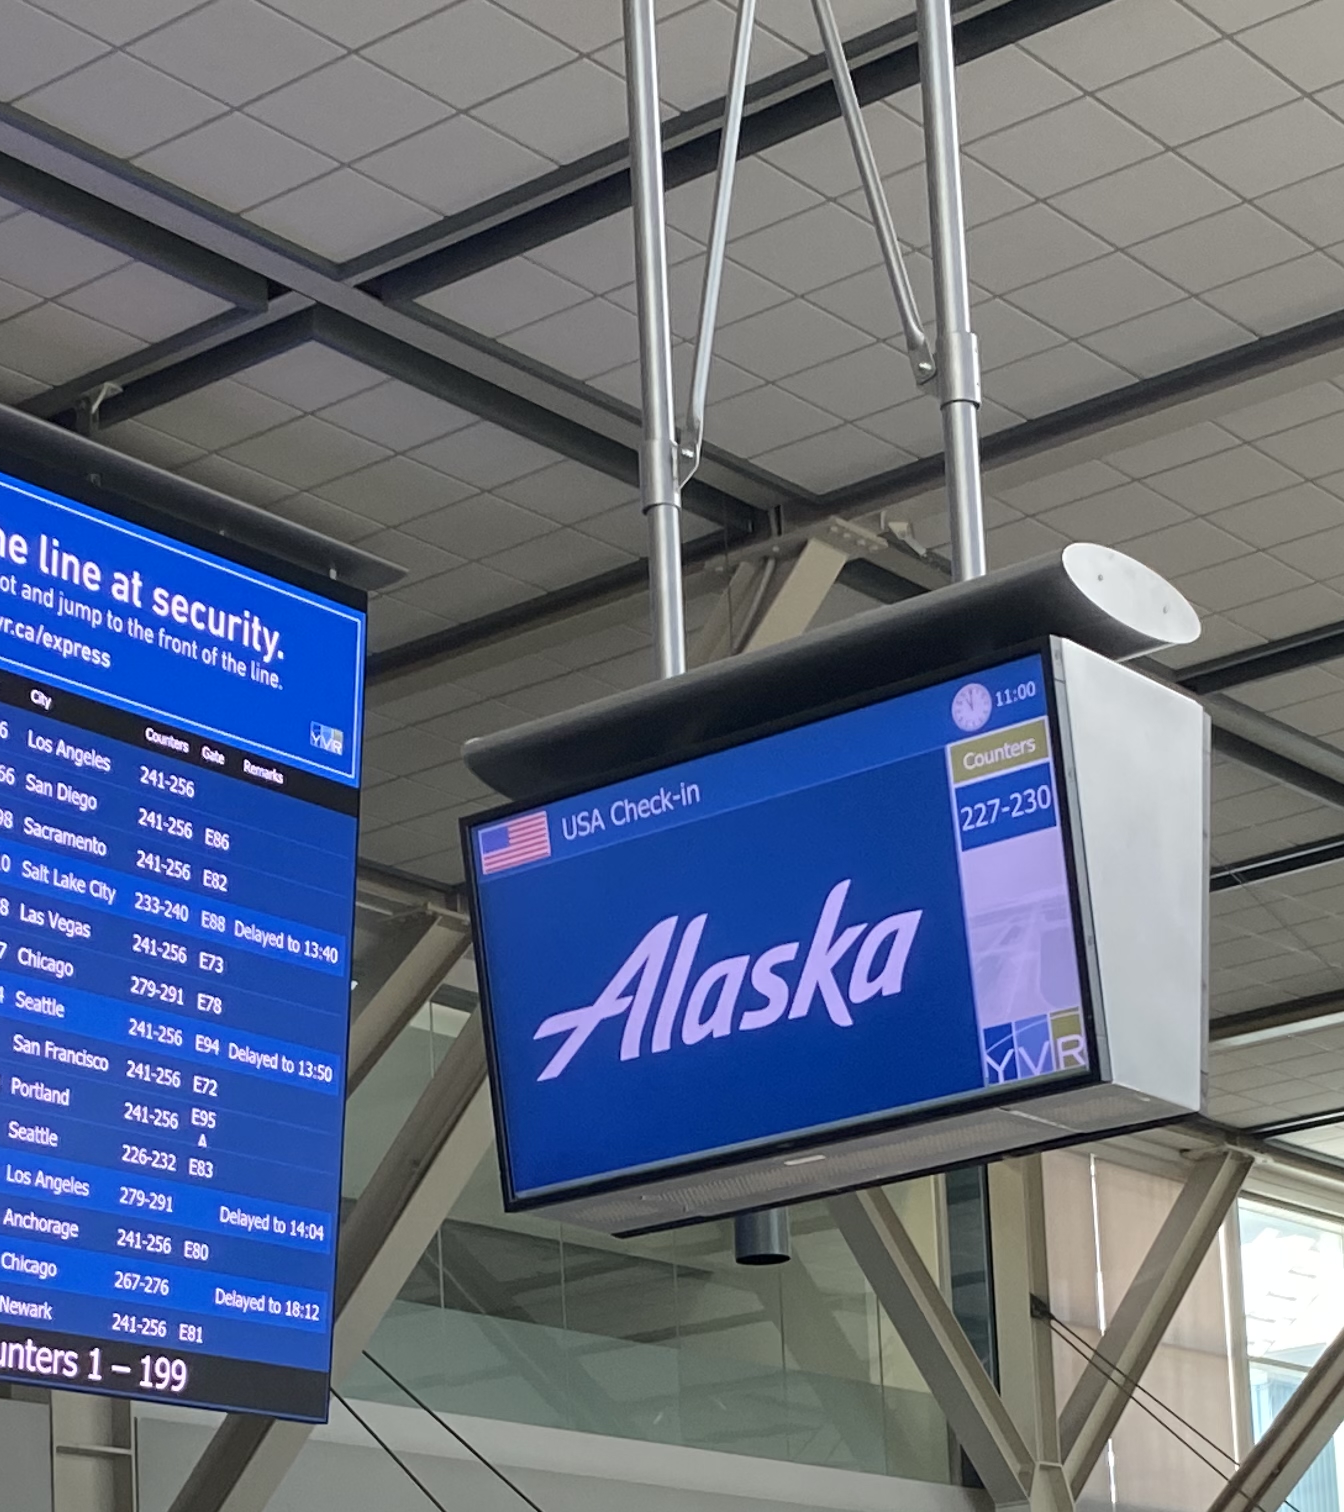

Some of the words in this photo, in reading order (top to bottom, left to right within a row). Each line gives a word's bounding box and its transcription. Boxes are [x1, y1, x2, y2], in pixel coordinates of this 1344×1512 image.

[39, 533, 102, 591] line
[111, 568, 143, 608] at
[152, 585, 286, 661] security.
[21, 578, 54, 610] and
[56, 591, 103, 629] jump
[107, 610, 124, 632] to
[127, 616, 154, 644] the
[158, 627, 198, 660] front
[201, 643, 218, 666] of
[221, 649, 247, 676] the
[250, 658, 284, 690] line.
[995, 679, 1037, 708] 11:00
[963, 735, 1036, 770] Counters
[562, 811, 606, 842] USA
[610, 781, 701, 828] Check-in
[960, 784, 1052, 831] 227-230
[533, 878, 922, 1081] Alaska
[986, 1036, 1086, 1084] YVR
[87, 1348, 102, 1381] 1
[139, 1355, 188, 1393] 199
